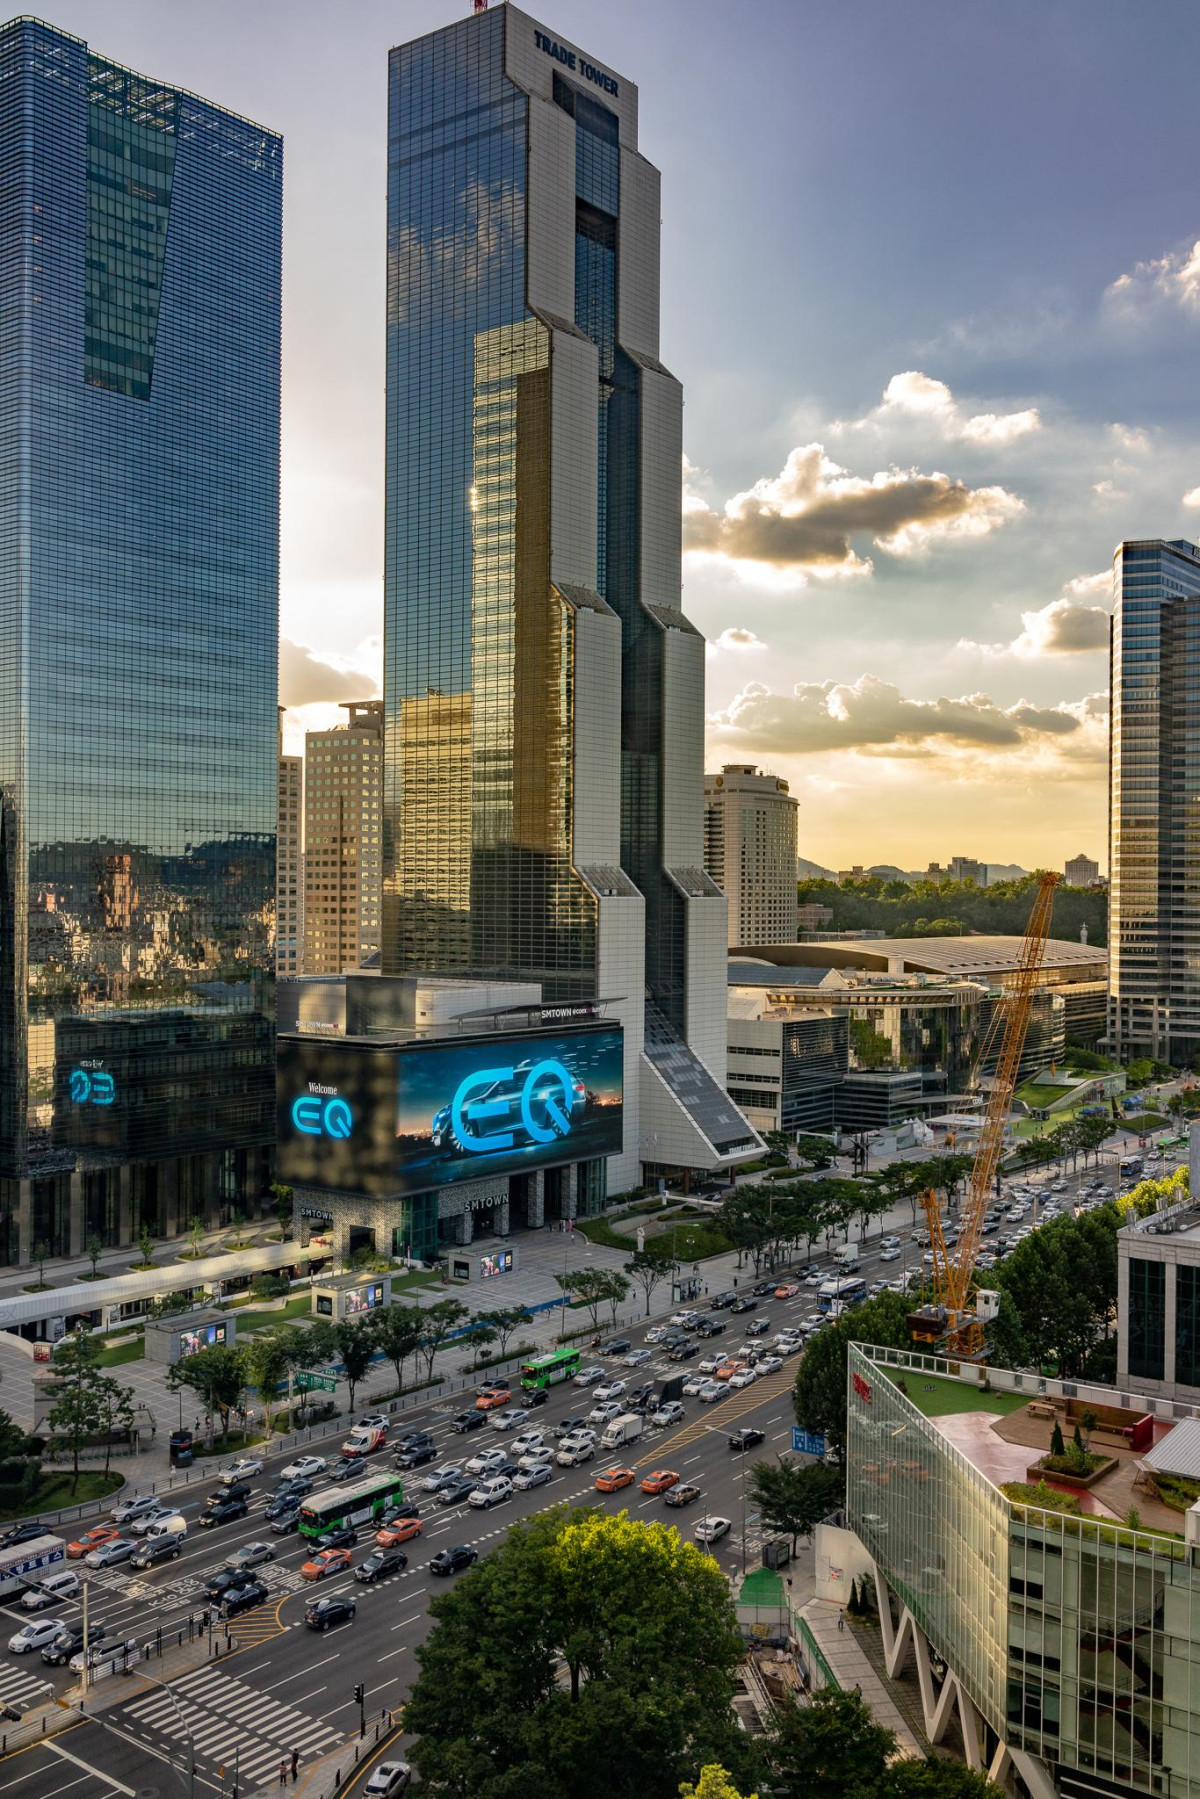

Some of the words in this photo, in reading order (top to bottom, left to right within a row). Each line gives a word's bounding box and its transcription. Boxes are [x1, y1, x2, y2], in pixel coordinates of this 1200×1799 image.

[534, 29, 576, 71] TRADE
[579, 58, 619, 97] TOWER
[541, 1008, 572, 1019] SMTOWN
[308, 1082, 338, 1096] Welcome
[452, 1059, 573, 1151] EQ
[292, 1097, 352, 1138] EQ
[464, 1193, 509, 1212] SMTOWN
[301, 1207, 334, 1221] SMTOWN
